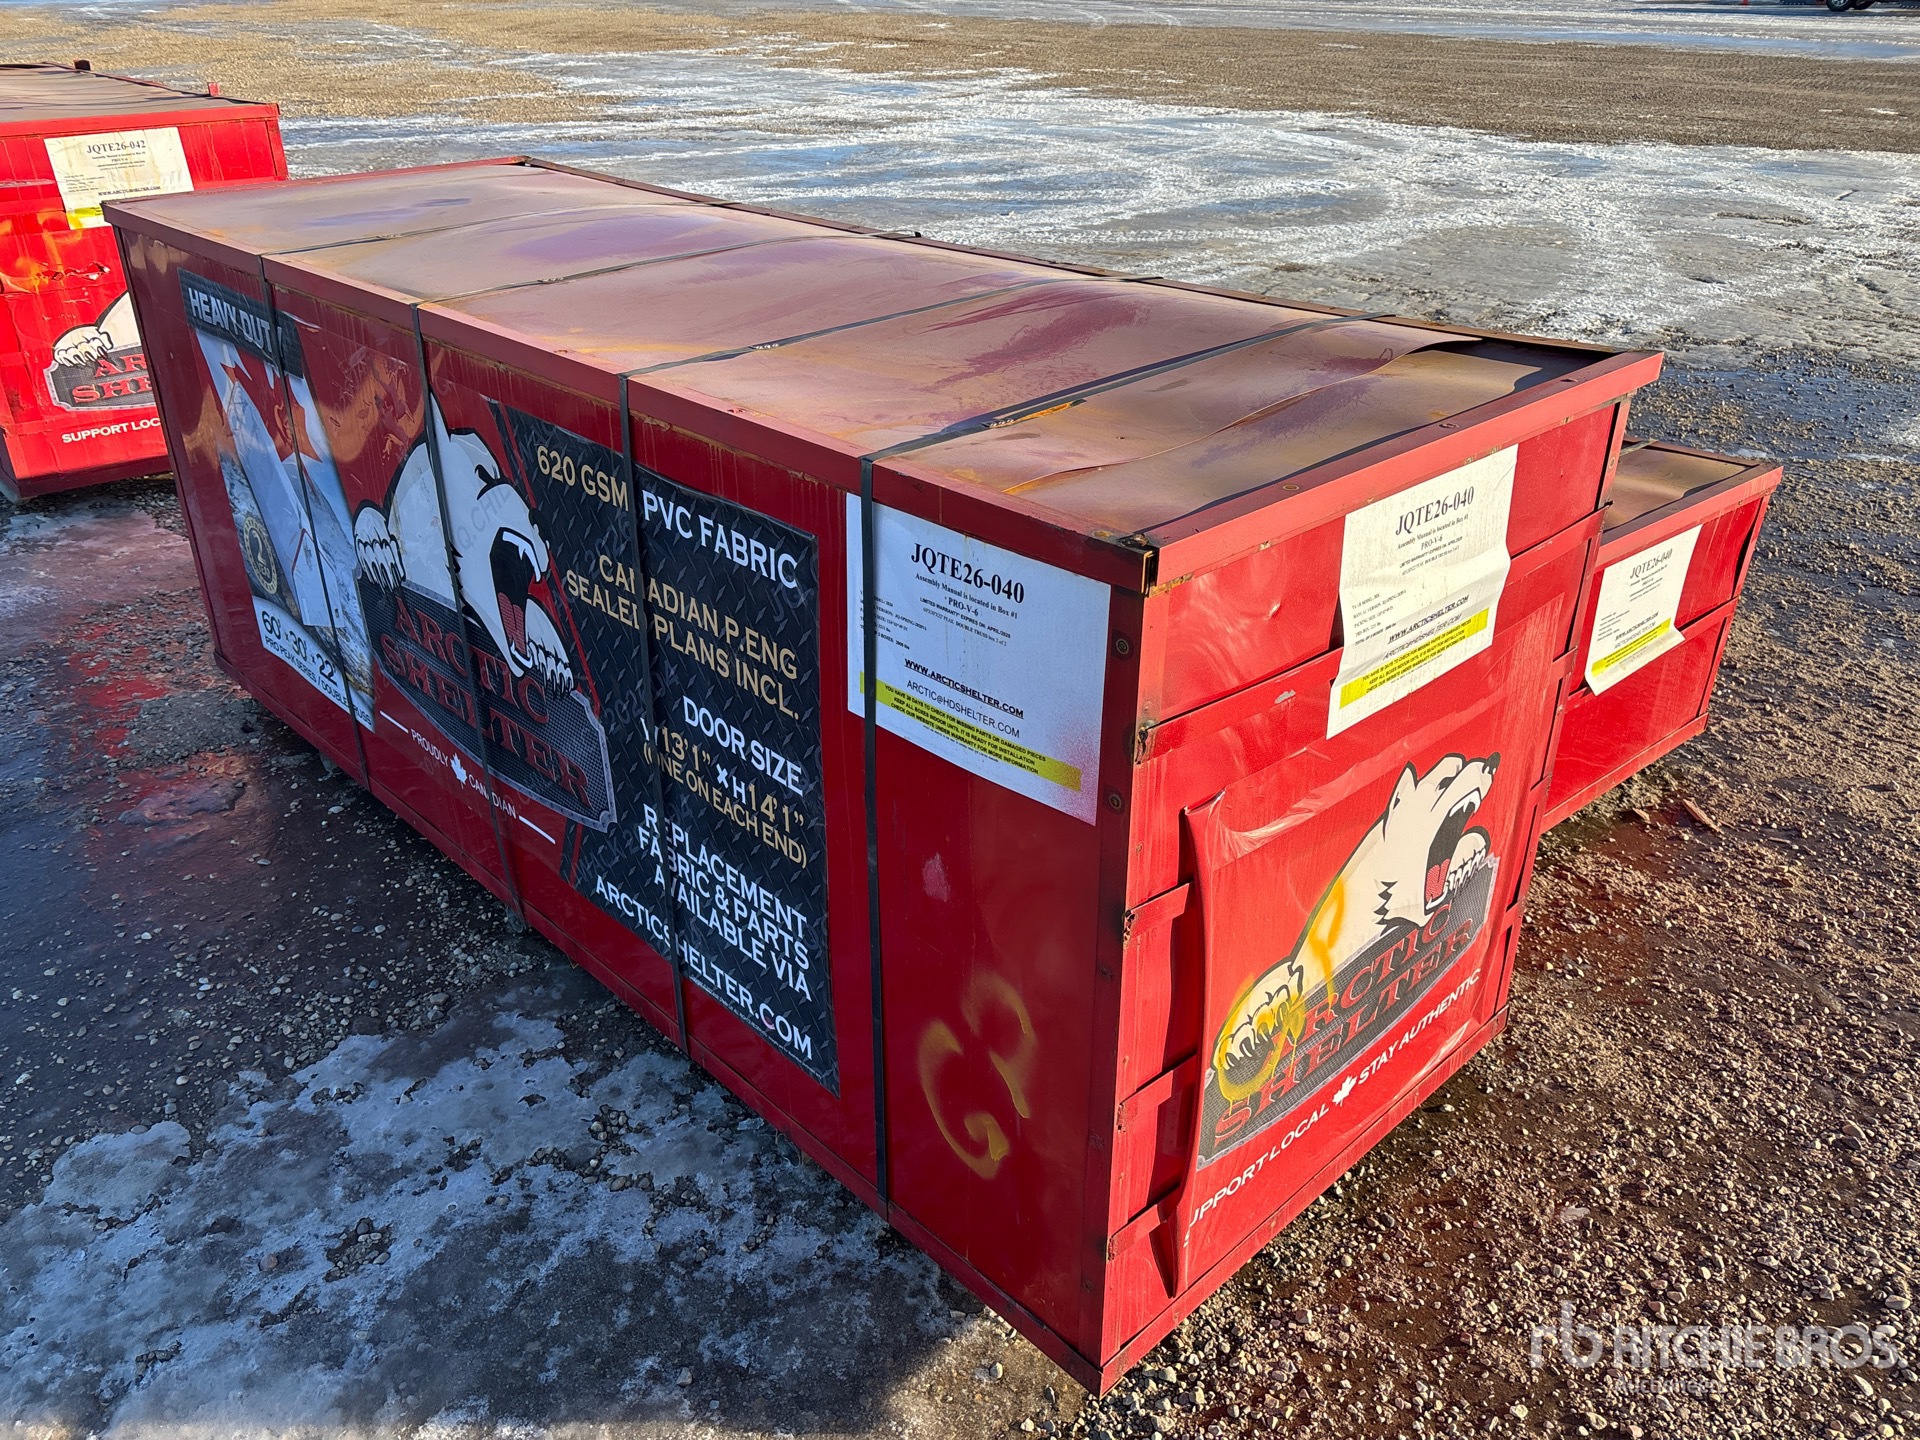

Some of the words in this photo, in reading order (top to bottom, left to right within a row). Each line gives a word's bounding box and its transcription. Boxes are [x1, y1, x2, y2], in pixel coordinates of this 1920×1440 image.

[86, 140, 146, 154] JQTE26-042
[188, 287, 239, 335] HEAVY
[62, 422, 129, 443] SUPPORT
[537, 445, 576, 487] 620
[580, 464, 629, 512] GSM
[642, 489, 693, 540] PVC
[698, 514, 798, 589] FABRIC
[1395, 486, 1474, 536] JQTE26-040
[1397, 536, 1415, 551] Assembly
[1416, 528, 1432, 541] Manual
[1436, 519, 1451, 533] located
[911, 542, 1024, 604] JQTE26-040
[915, 572, 939, 589] Assembly
[941, 583, 962, 597] Manual
[963, 591, 967, 599] is
[968, 593, 989, 608] located
[990, 601, 996, 611] in
[997, 605, 1009, 616] Box
[1010, 610, 1017, 619] #1
[948, 596, 978, 616] PRO-V-6
[724, 614, 798, 681] P.ENG
[1387, 594, 1469, 644] WWW.ARCTICSHELTER.COM
[395, 596, 549, 723] ARCTIC
[653, 613, 730, 679] PLANS
[735, 658, 800, 721] INCL.
[904, 657, 1024, 720] WWW.ARCTICSHELTER.COM
[352, 704, 372, 726] RUSS
[380, 634, 594, 810] SHELTER
[885, 685, 893, 693] YOU
[894, 689, 905, 698] HAVE
[912, 697, 922, 707] DAYS
[931, 706, 945, 717] CHECK
[946, 713, 955, 722] FOR
[976, 727, 991, 739] PARTS
[992, 735, 999, 743] OR
[1000, 738, 1026, 755] DAMAGED
[1027, 749, 1046, 762] PIECES
[891, 701, 904, 712] CHECK
[905, 708, 915, 718] OUR
[916, 714, 934, 727] WEBSITE
[950, 731, 975, 748] WARRANTY
[977, 743, 987, 753] FOR
[988, 748, 1002, 759] MORE
[1003, 754, 1038, 775] INFORMATION
[894, 696, 904, 706] KEEP
[905, 701, 913, 710] ALL
[914, 706, 928, 717] BOXES
[946, 721, 959, 732] UNTIL
[971, 733, 987, 745] READY
[988, 741, 997, 750] FOR
[998, 744, 1035, 767] INSTALLATION
[907, 678, 1019, 739] ARCTIC@HDSHELTER.COM
[410, 728, 449, 768] PROUDLY
[682, 695, 746, 761] DOOR
[750, 740, 803, 797] SIZE
[686, 770, 710, 802] ON
[712, 787, 758, 838] EACH
[762, 826, 807, 870] END)
[638, 826, 710, 900] FABRIC
[715, 883, 730, 916] &
[734, 898, 810, 972] PARTS
[643, 803, 807, 940] REPLACEMENT
[596, 875, 813, 1061] ARCTICSHELTER.COM
[770, 951, 813, 1003] VIA
[1262, 903, 1452, 1070] ARCTIC
[1214, 919, 1473, 1147] SHELTER
[1269, 1103, 1330, 1162] LOCAL
[1358, 1040, 1399, 1085] STAY
[1398, 968, 1482, 1050] AUTHENTIC
